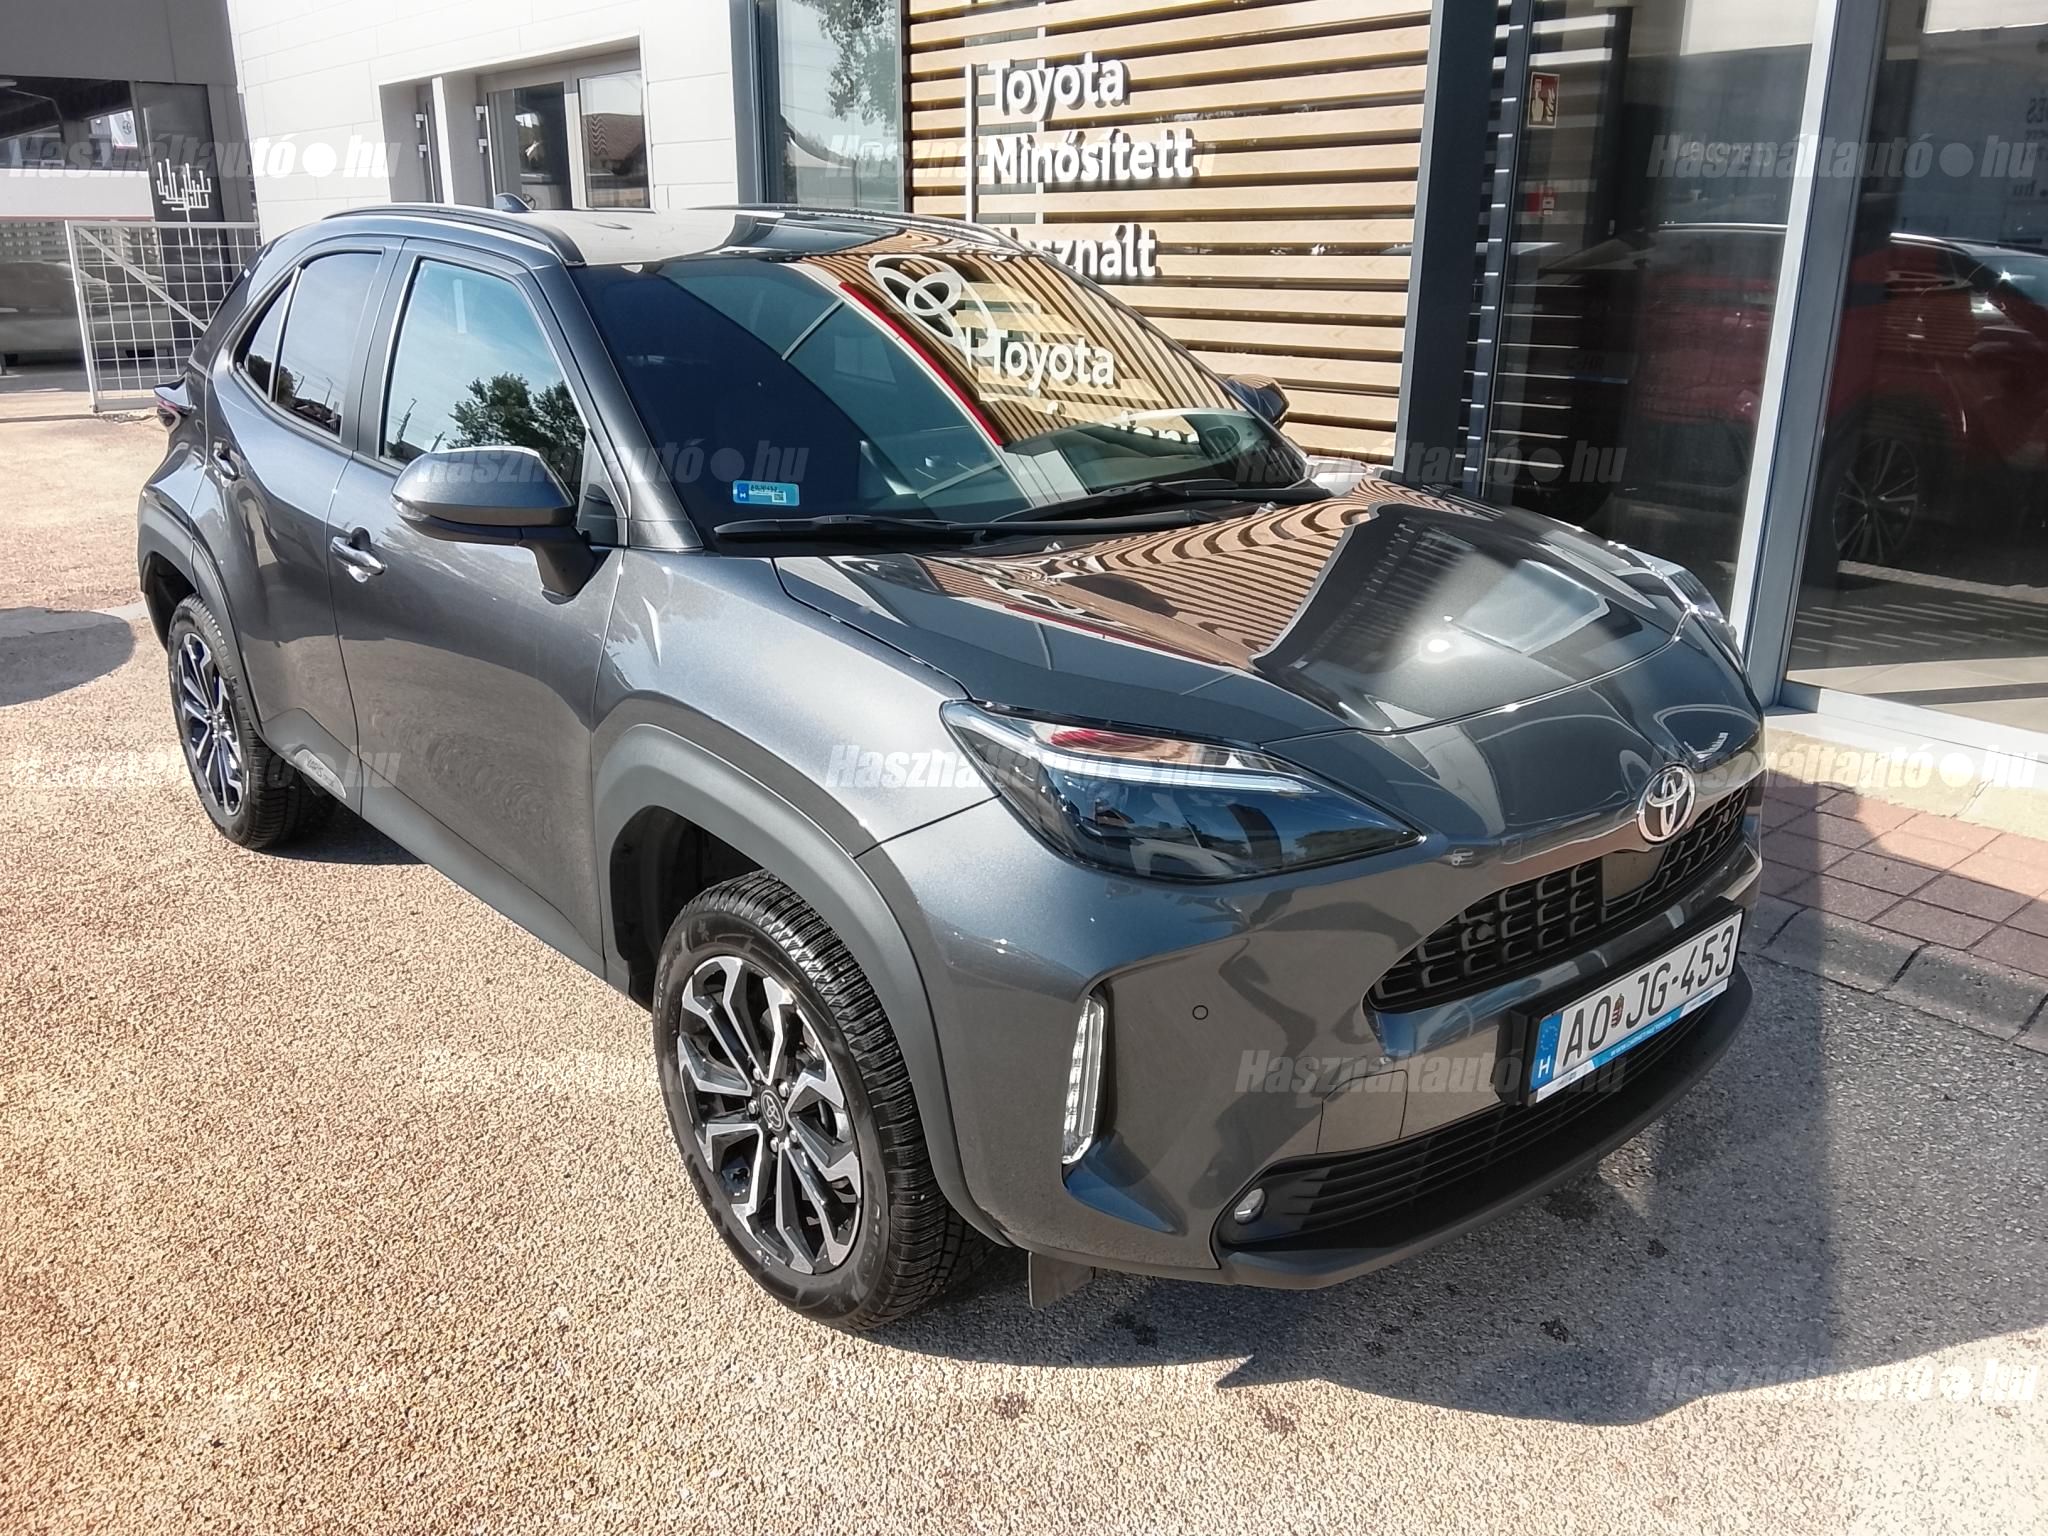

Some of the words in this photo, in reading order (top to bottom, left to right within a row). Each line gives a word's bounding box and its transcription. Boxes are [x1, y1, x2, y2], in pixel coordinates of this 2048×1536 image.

[988, 52, 1124, 122] Toyota
[987, 129, 1193, 184] Minősített
[987, 328, 1114, 391] Toyota
[1562, 995, 1611, 1067] AO
[1626, 925, 1734, 1029] JG-453
[1537, 1055, 1551, 1078] H
